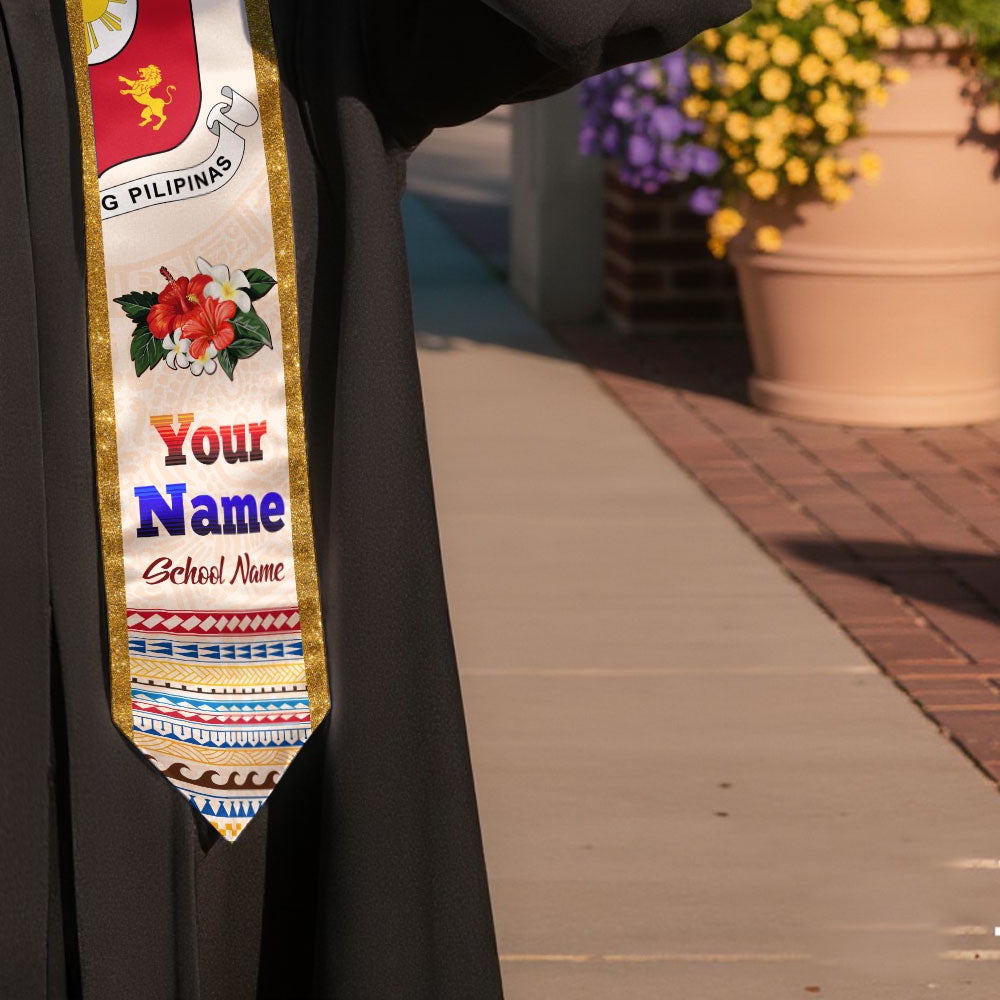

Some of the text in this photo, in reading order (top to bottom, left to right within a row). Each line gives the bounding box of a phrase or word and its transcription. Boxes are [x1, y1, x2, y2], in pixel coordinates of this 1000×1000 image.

[128, 155, 232, 204] PILIPINAS
[150, 412, 267, 467] Your
[133, 482, 286, 538] Name
[142, 551, 286, 586] School Name
